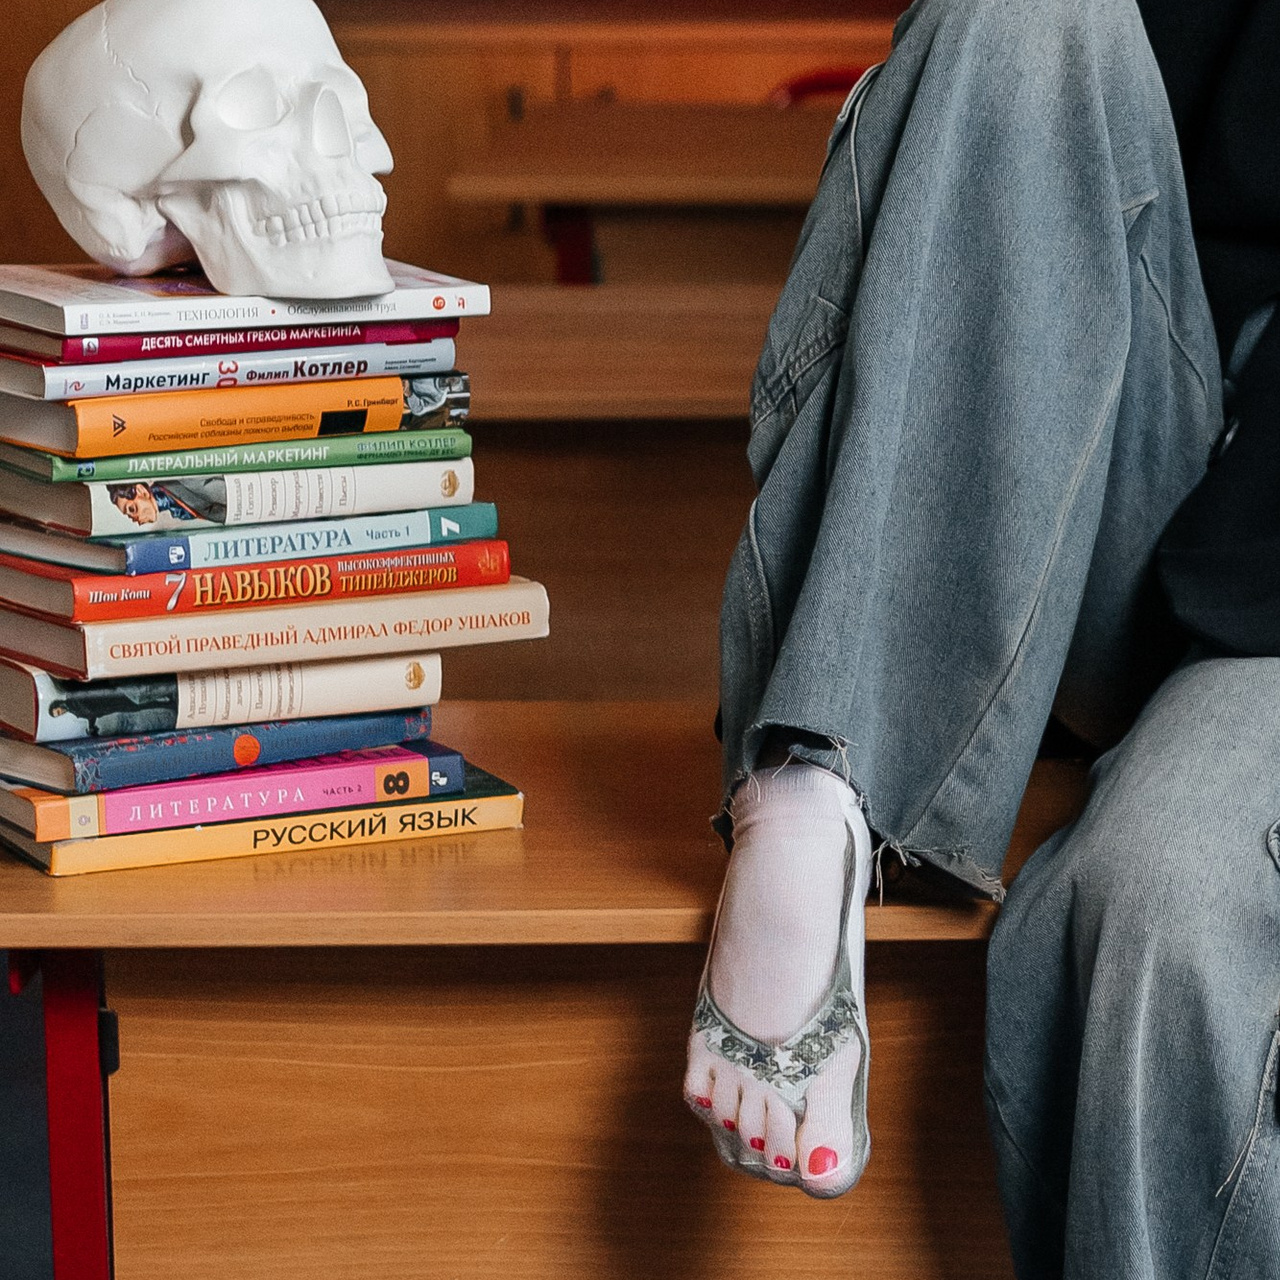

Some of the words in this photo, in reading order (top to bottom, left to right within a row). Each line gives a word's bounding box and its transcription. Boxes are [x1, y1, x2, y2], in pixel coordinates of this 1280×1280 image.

[176, 307, 259, 322] ТЕХНОЛОГИЯ
[287, 302, 373, 317] Обслуживающий
[375, 302, 397, 313] труд
[141, 336, 183, 351] ДЕСЯТЬ
[184, 332, 245, 347] СМЕРТНЫХ
[247, 328, 287, 342] ГРЕХОВ
[289, 325, 361, 340] МАРКЕТИНГА
[105, 371, 210, 392] Маркетинг
[246, 369, 289, 382] Филип
[292, 358, 369, 378] Котлер
[200, 417, 237, 427] Свобода
[357, 441, 406, 453] ФИЛИП
[408, 437, 457, 448] КОТЛЕР
[127, 449, 238, 473] ЛАТЕРАЛЬНЫЙ
[243, 446, 330, 465] МАРКЕТИНГ
[440, 516, 460, 537] 7
[204, 528, 352, 561] ЛИТЕРАТУРА
[365, 528, 401, 541] Часть
[337, 551, 455, 572] ВЫСОКОЭФФЕКТИВНЫХ
[165, 572, 187, 611] 7
[192, 563, 332, 607] НАВЫКОВ
[340, 566, 458, 592] ТИНЕЙДЖЕРОВ
[88, 590, 118, 604] Шон
[120, 588, 150, 601] Кови
[109, 634, 181, 660] СВЯТОЙ
[187, 625, 298, 653] ПРАВЕДНЫЙ
[302, 623, 389, 645] АДМИРАЛ
[393, 616, 453, 636] ФЕДОР
[458, 610, 532, 631] УШАКОВ
[383, 771, 410, 795] 8
[129, 786, 306, 822] ЛИТЕРАТУРА
[322, 785, 354, 797] ЧАСТЬ
[356, 784, 363, 793] 2
[253, 812, 387, 849] РУССКИЙ
[398, 806, 479, 833] ЯЗЫК
